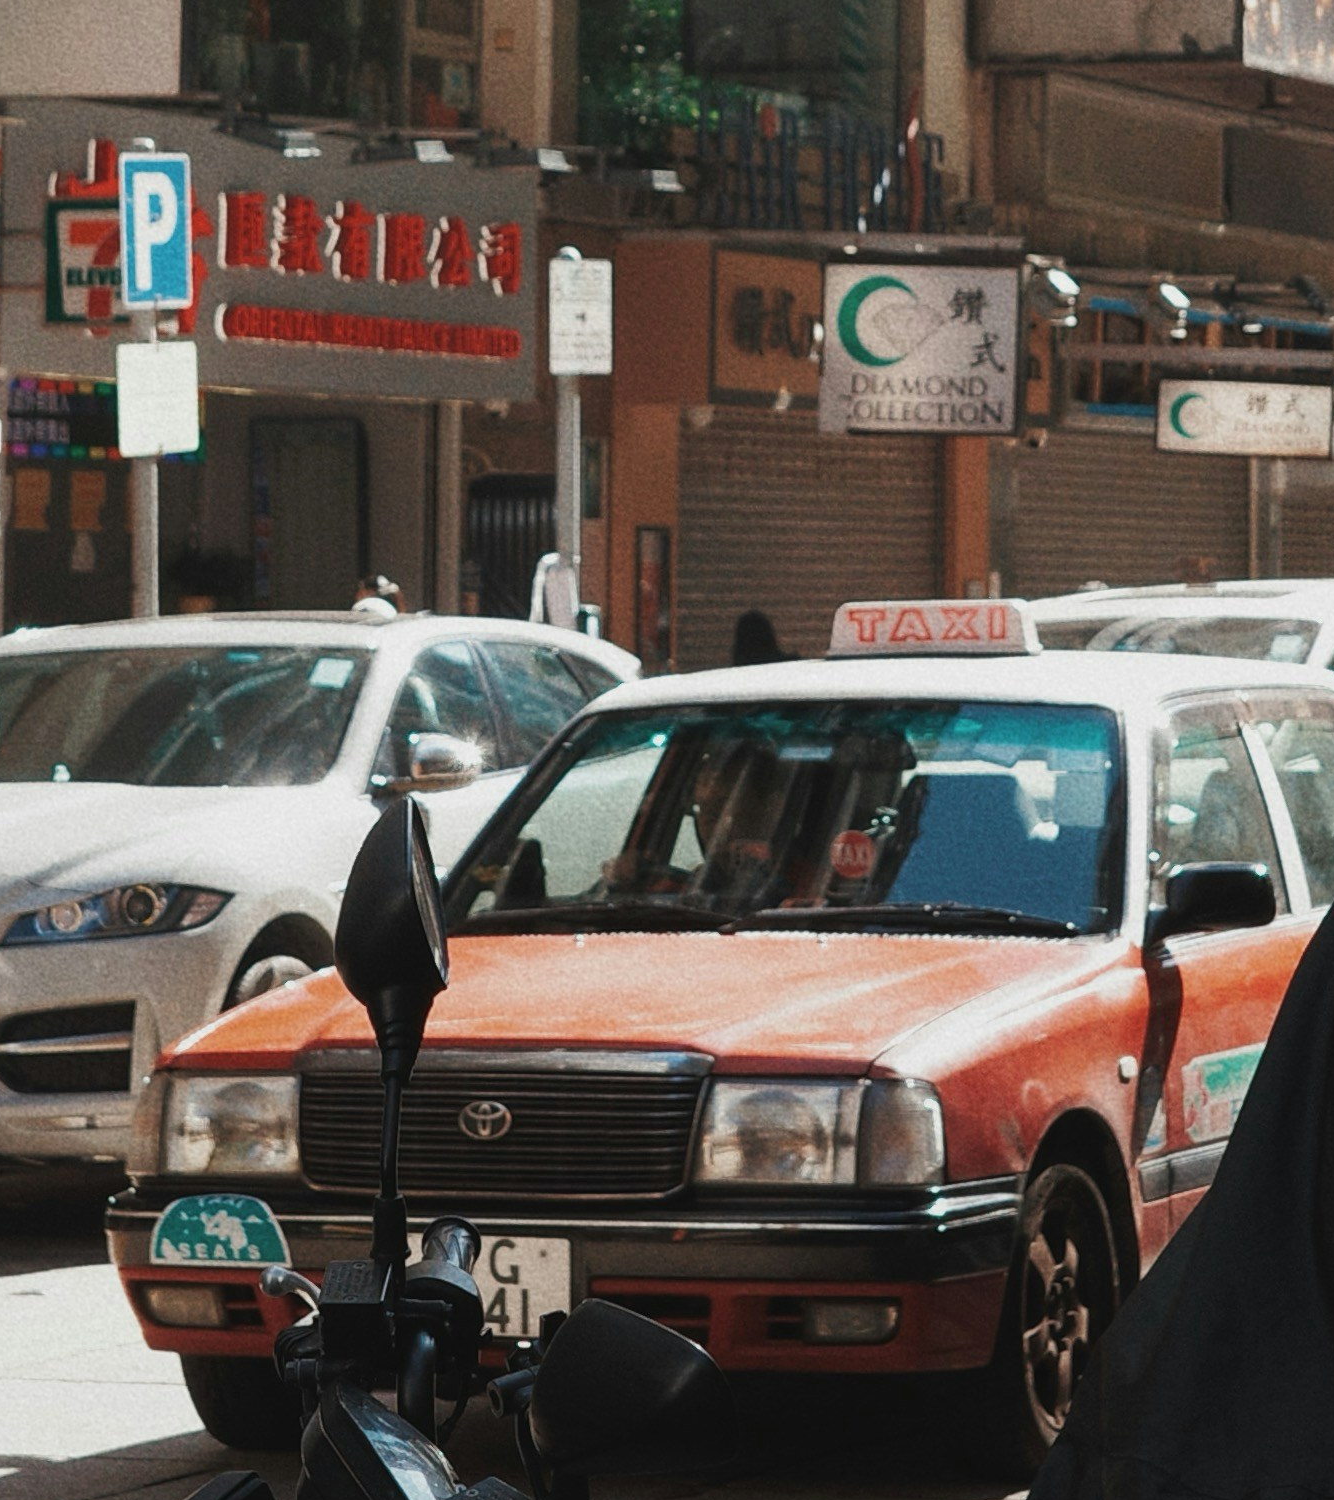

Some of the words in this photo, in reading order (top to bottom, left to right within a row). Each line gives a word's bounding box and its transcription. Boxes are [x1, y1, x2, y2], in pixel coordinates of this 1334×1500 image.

[132, 171, 178, 291] P
[851, 373, 988, 397] DIAMOND
[847, 400, 1003, 424] OLLECTION
[848, 606, 1007, 643] TAXI
[490, 1238, 519, 1285] G
[484, 1286, 529, 1335] 41
